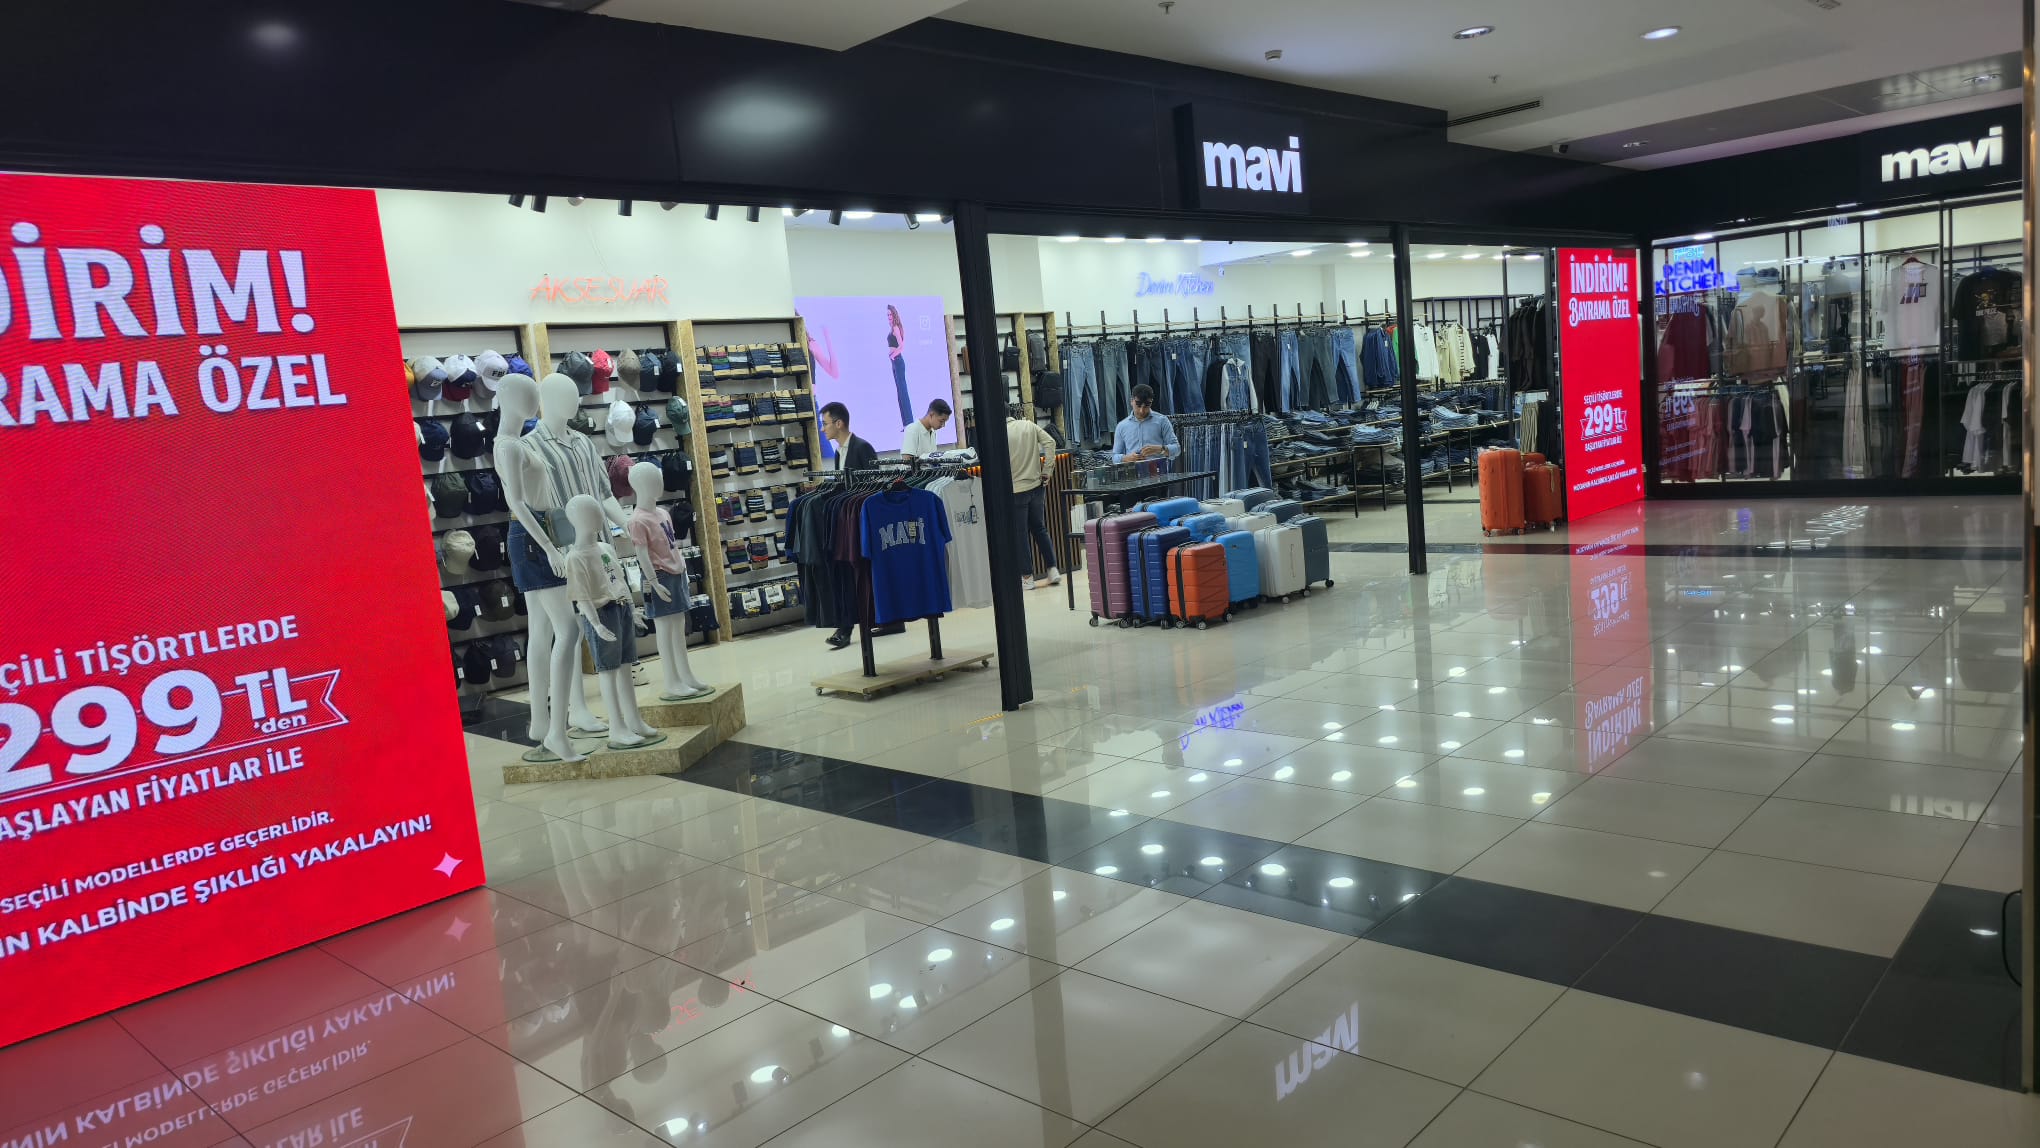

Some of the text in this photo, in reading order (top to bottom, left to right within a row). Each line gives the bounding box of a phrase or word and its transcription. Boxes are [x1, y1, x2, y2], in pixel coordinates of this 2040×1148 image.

[1203, 135, 1302, 193] mavi
[1881, 125, 2003, 182] mavi
[0, 221, 315, 340] İRİM!
[530, 276, 670, 304] AKSESUAR
[1570, 254, 1629, 294] İNDİRİM!
[1655, 271, 1724, 294] KTCHEN
[1663, 257, 1715, 278] DENIM
[1569, 297, 1611, 327] BAYRAMA
[1613, 295, 1631, 318] ÖZEL
[198, 344, 347, 413] ÖZEL
[1584, 403, 1613, 437] 299
[75, 615, 299, 676] TİŞÖRTLERDE
[0, 667, 308, 793] 299 TL
[136, 757, 263, 807] FİYATLAR
[266, 746, 305, 774] İLE
[0, 810, 335, 914] SEÇİLİ MODELLERDE GEÇERLİDİR.
[37, 886, 188, 946] KALBİNDE
[193, 856, 286, 903] ŞIKLIĞI
[291, 814, 432, 869] YAKALAYIN!
